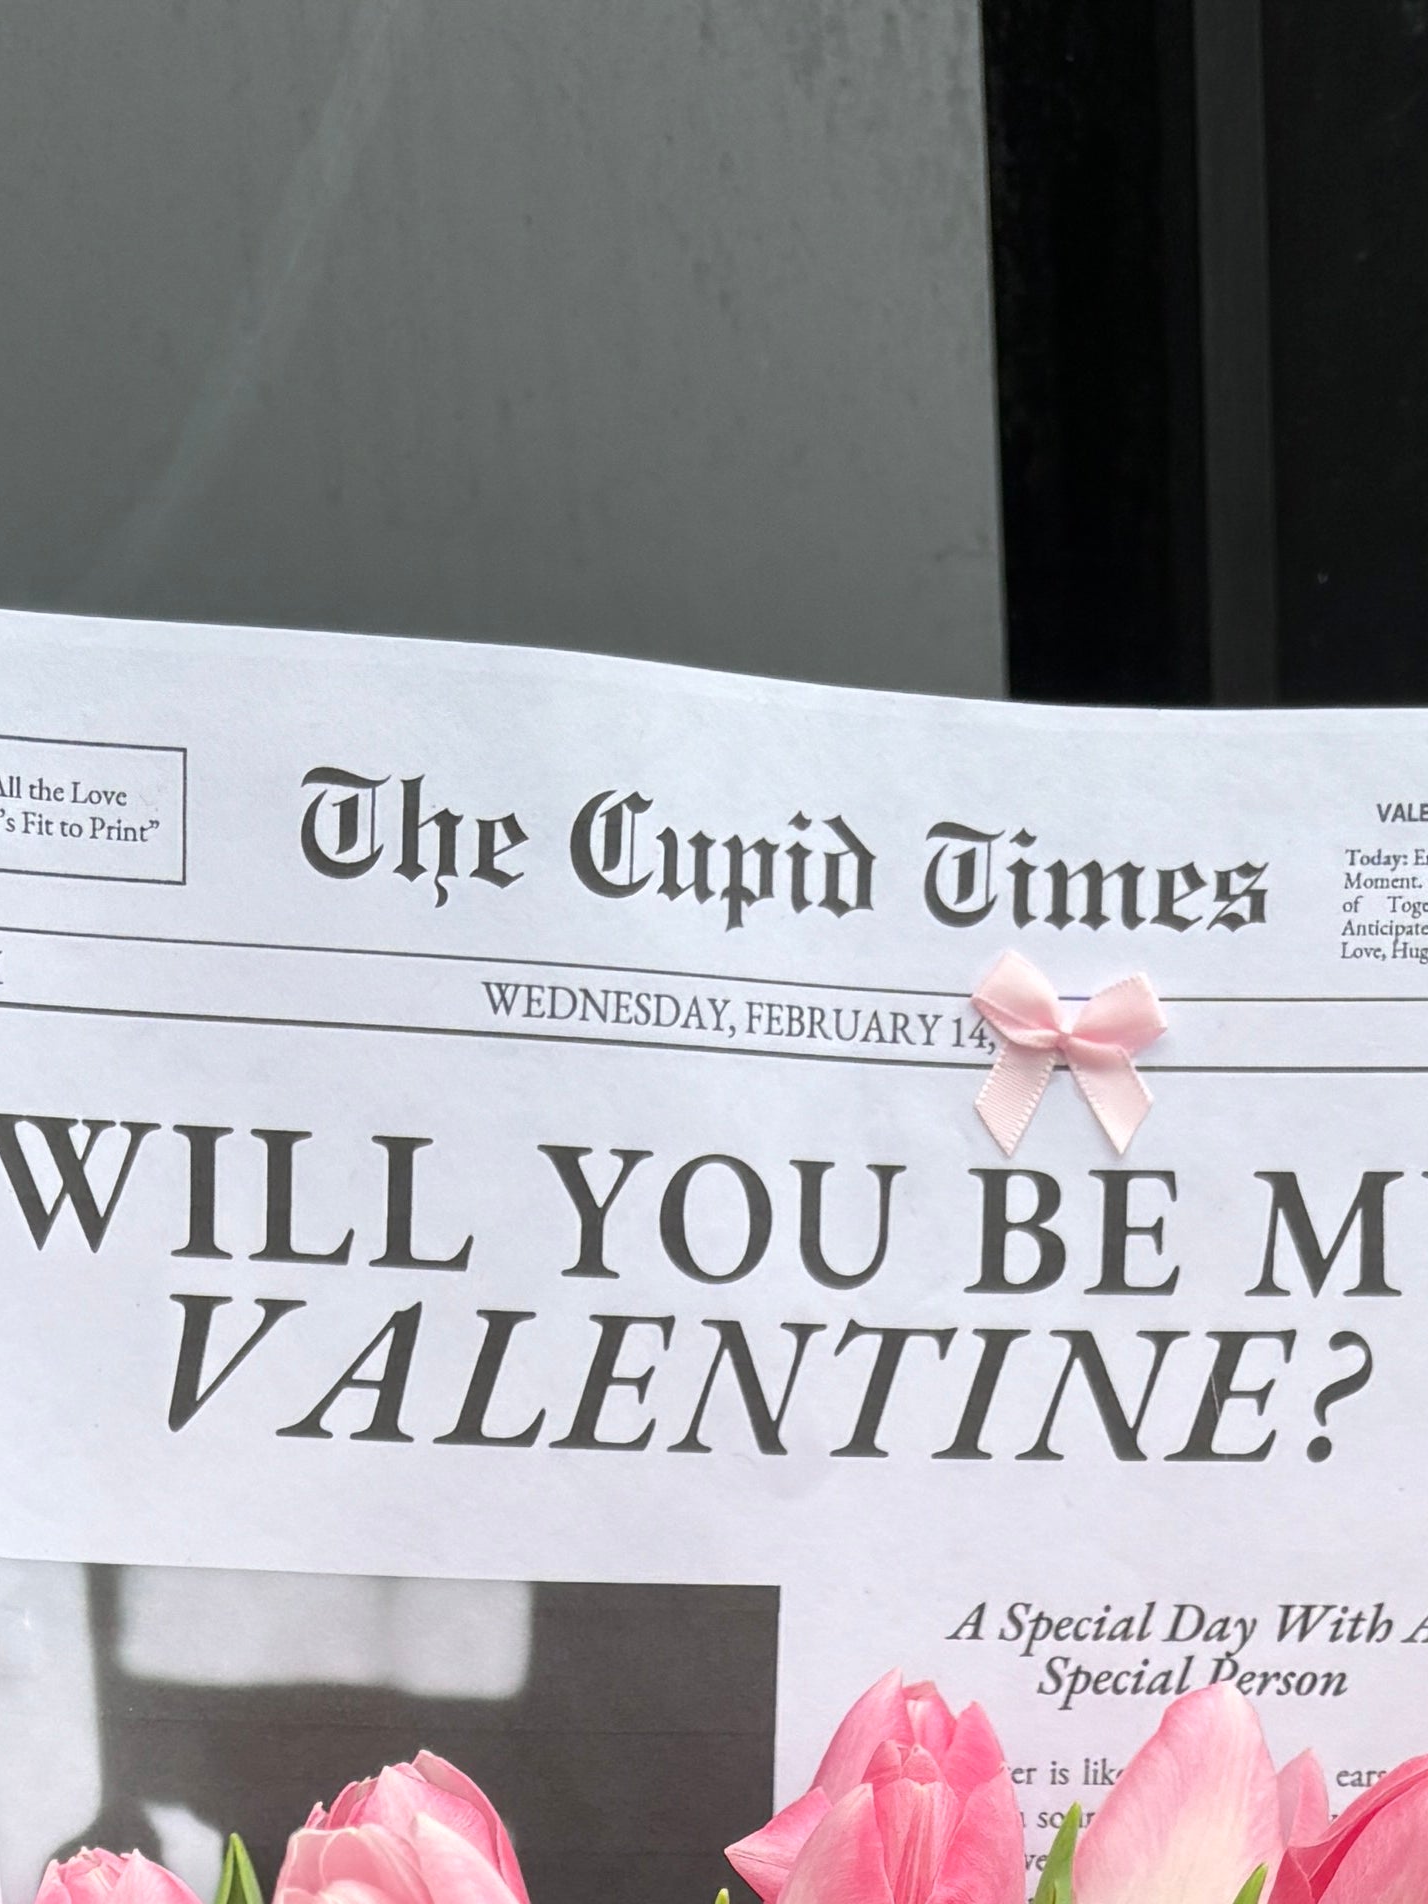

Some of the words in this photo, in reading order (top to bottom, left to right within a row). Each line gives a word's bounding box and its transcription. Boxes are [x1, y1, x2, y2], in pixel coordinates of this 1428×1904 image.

[29, 777, 64, 801] the
[71, 781, 127, 806] Love
[22, 811, 53, 836] Fit
[60, 821, 82, 838] to
[300, 766, 530, 909] The
[571, 788, 875, 933] Cupid
[923, 820, 1270, 934] Times
[1345, 849, 1408, 871] Today:
[1343, 873, 1422, 889] Moment.
[1342, 896, 1363, 913] of
[1341, 943, 1386, 961] Love,
[481, 981, 737, 1037] WEDNESDAY,
[747, 1003, 940, 1048] FEBRUARY
[951, 1015, 996, 1055] 14,
[538, 1142, 908, 1290] YOU
[966, 1166, 1180, 1297] BE
[166, 1294, 1376, 1464] VALENTINE?
[946, 1601, 987, 1641] A
[999, 1601, 1156, 1657] Special
[1162, 1604, 1258, 1657] Day
[1276, 1604, 1393, 1643] With
[1037, 1656, 1194, 1709] Special
[1209, 1656, 1348, 1698] Person
[1050, 1760, 1070, 1785] is
